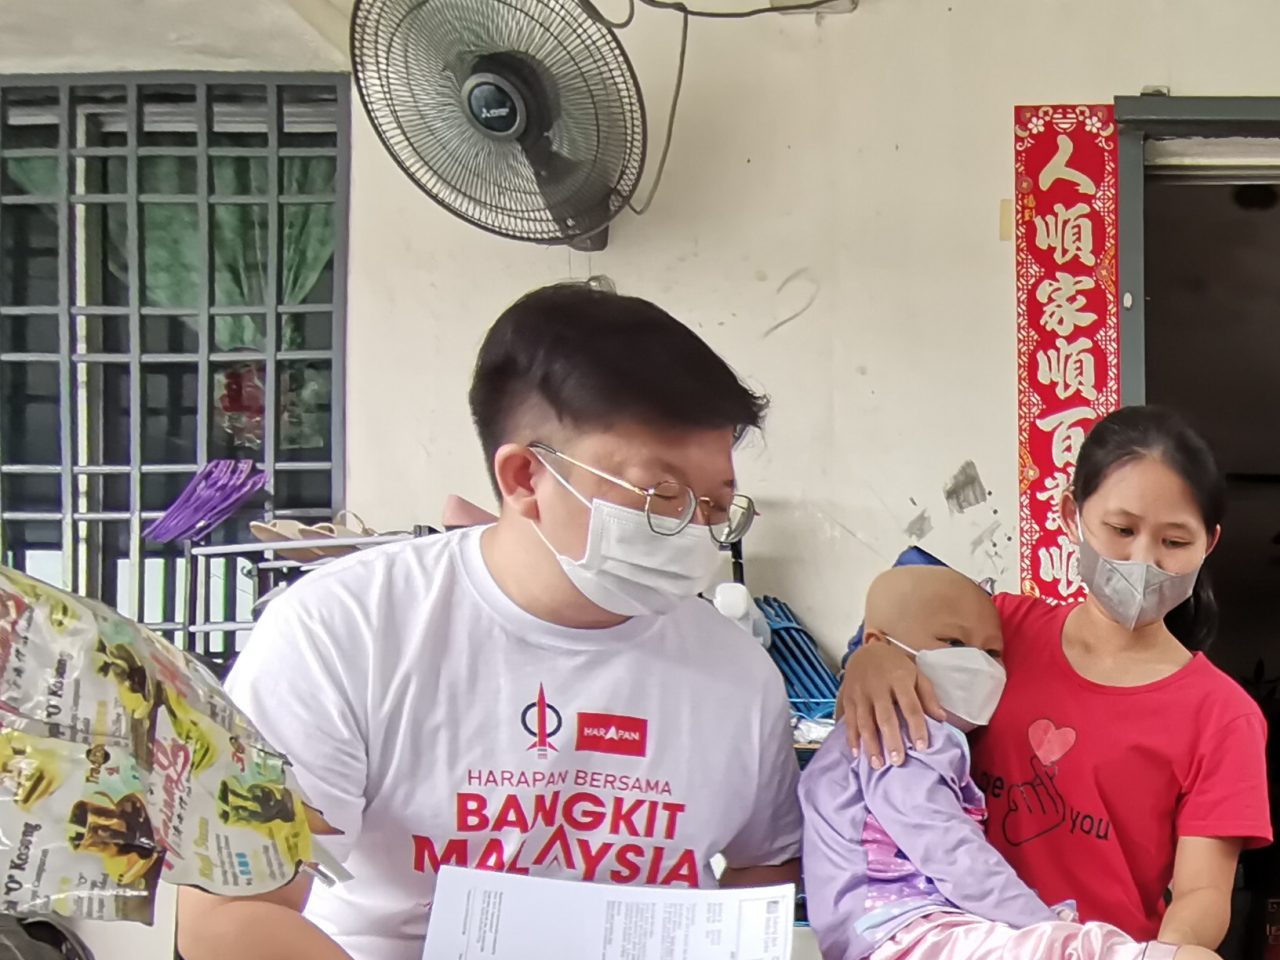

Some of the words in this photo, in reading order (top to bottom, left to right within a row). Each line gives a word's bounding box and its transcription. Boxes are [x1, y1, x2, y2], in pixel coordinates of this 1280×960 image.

[583, 725, 640, 741] HARAPAN
[468, 769, 568, 788] HARAPAN
[574, 769, 672, 796] BERSAMA
[456, 790, 686, 840] BANGKIT
[1069, 806, 1111, 841] you
[9, 822, 42, 871] Kosong
[411, 823, 700, 889] MALAYSIA
